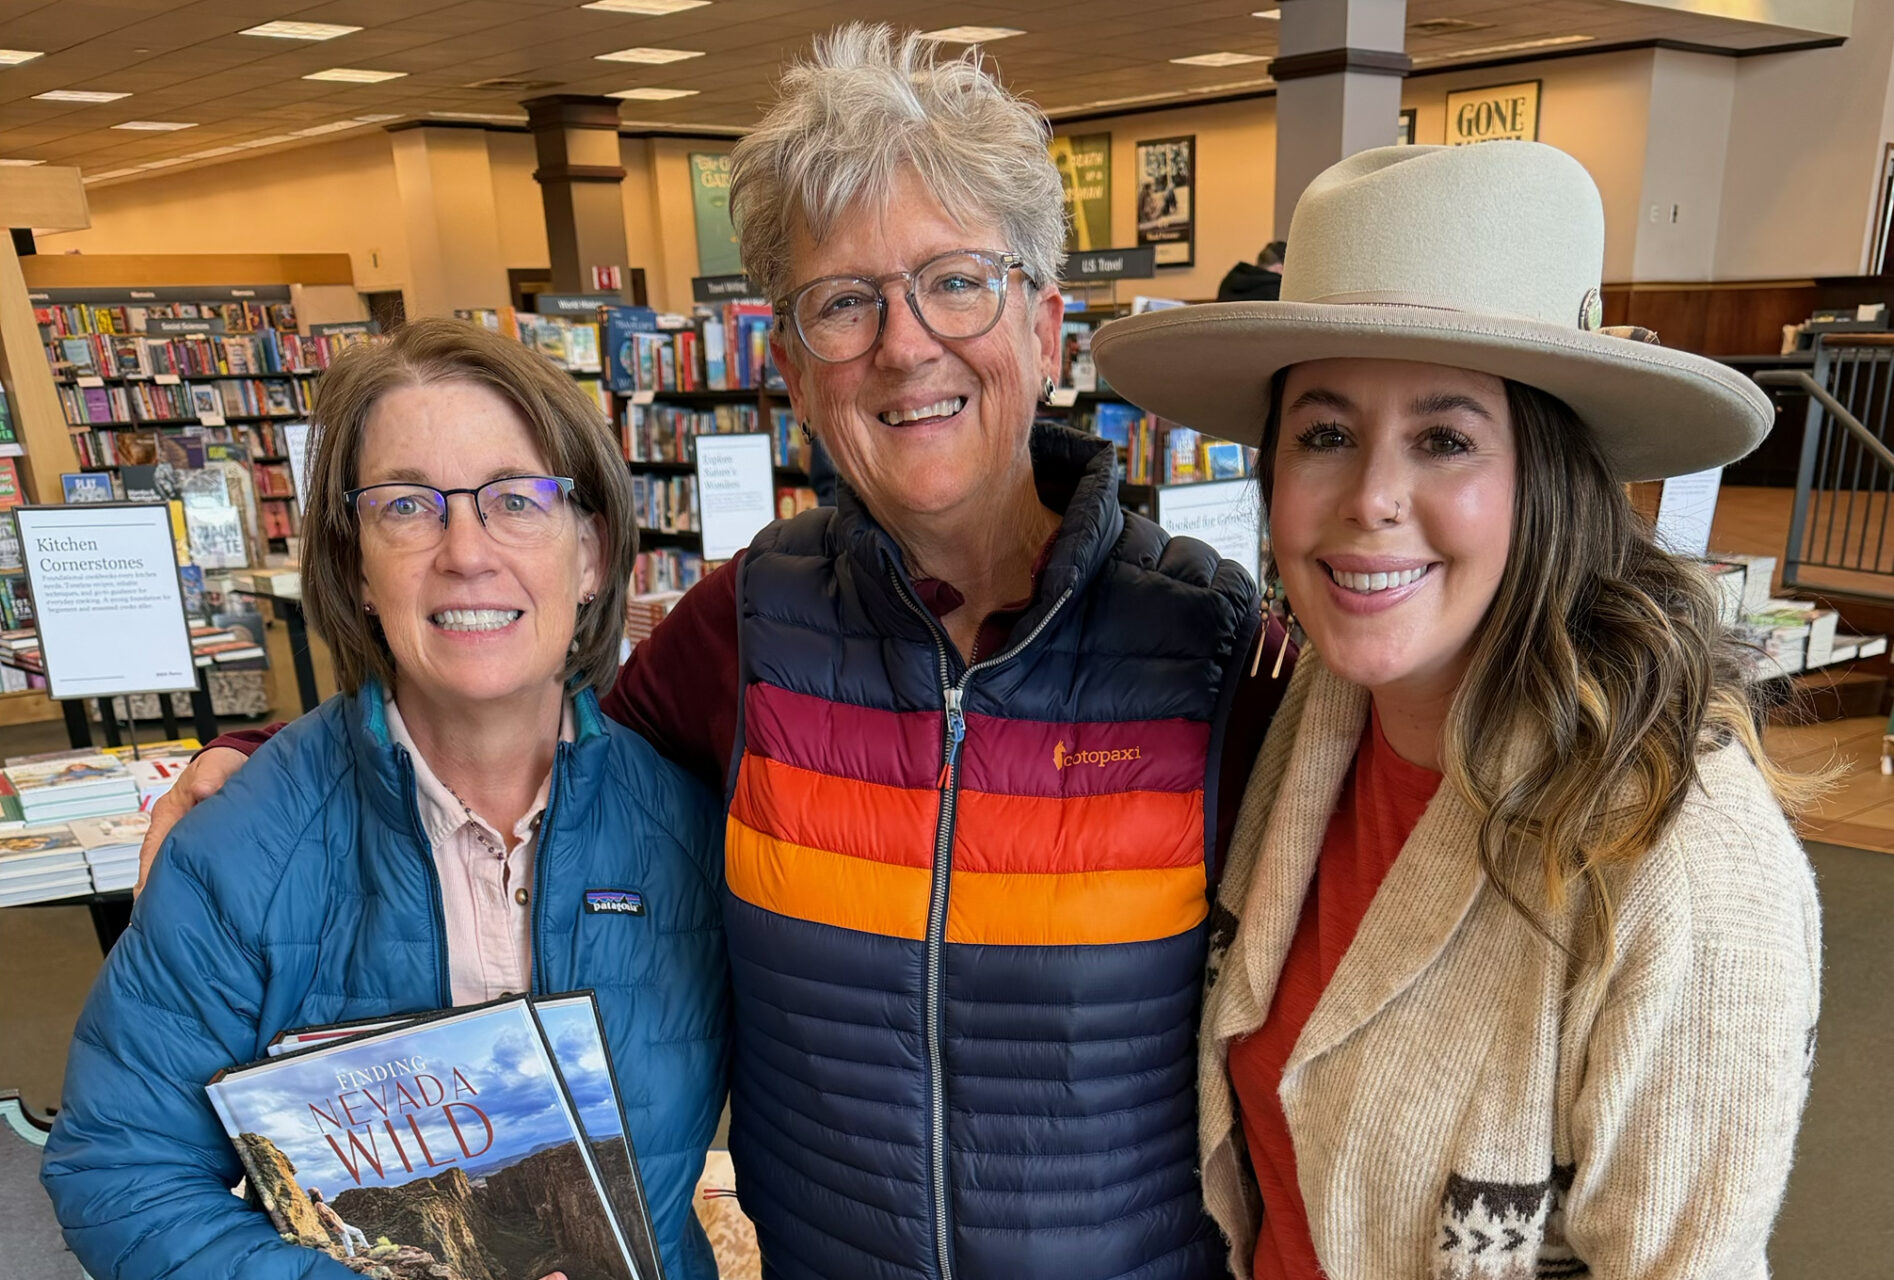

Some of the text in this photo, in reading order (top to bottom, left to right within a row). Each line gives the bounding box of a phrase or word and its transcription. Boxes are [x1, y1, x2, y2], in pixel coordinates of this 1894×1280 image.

[1457, 97, 1526, 138] GONE
[1099, 256, 1124, 272] Travel
[36, 537, 98, 553] Kitchen
[40, 557, 144, 572] Cornerstones
[1063, 745, 1142, 768] cotopaxi
[593, 902, 638, 912] patagonia
[337, 1055, 428, 1090] FINDING
[308, 1066, 479, 1135] NEVADA
[324, 1102, 495, 1186] WILD
